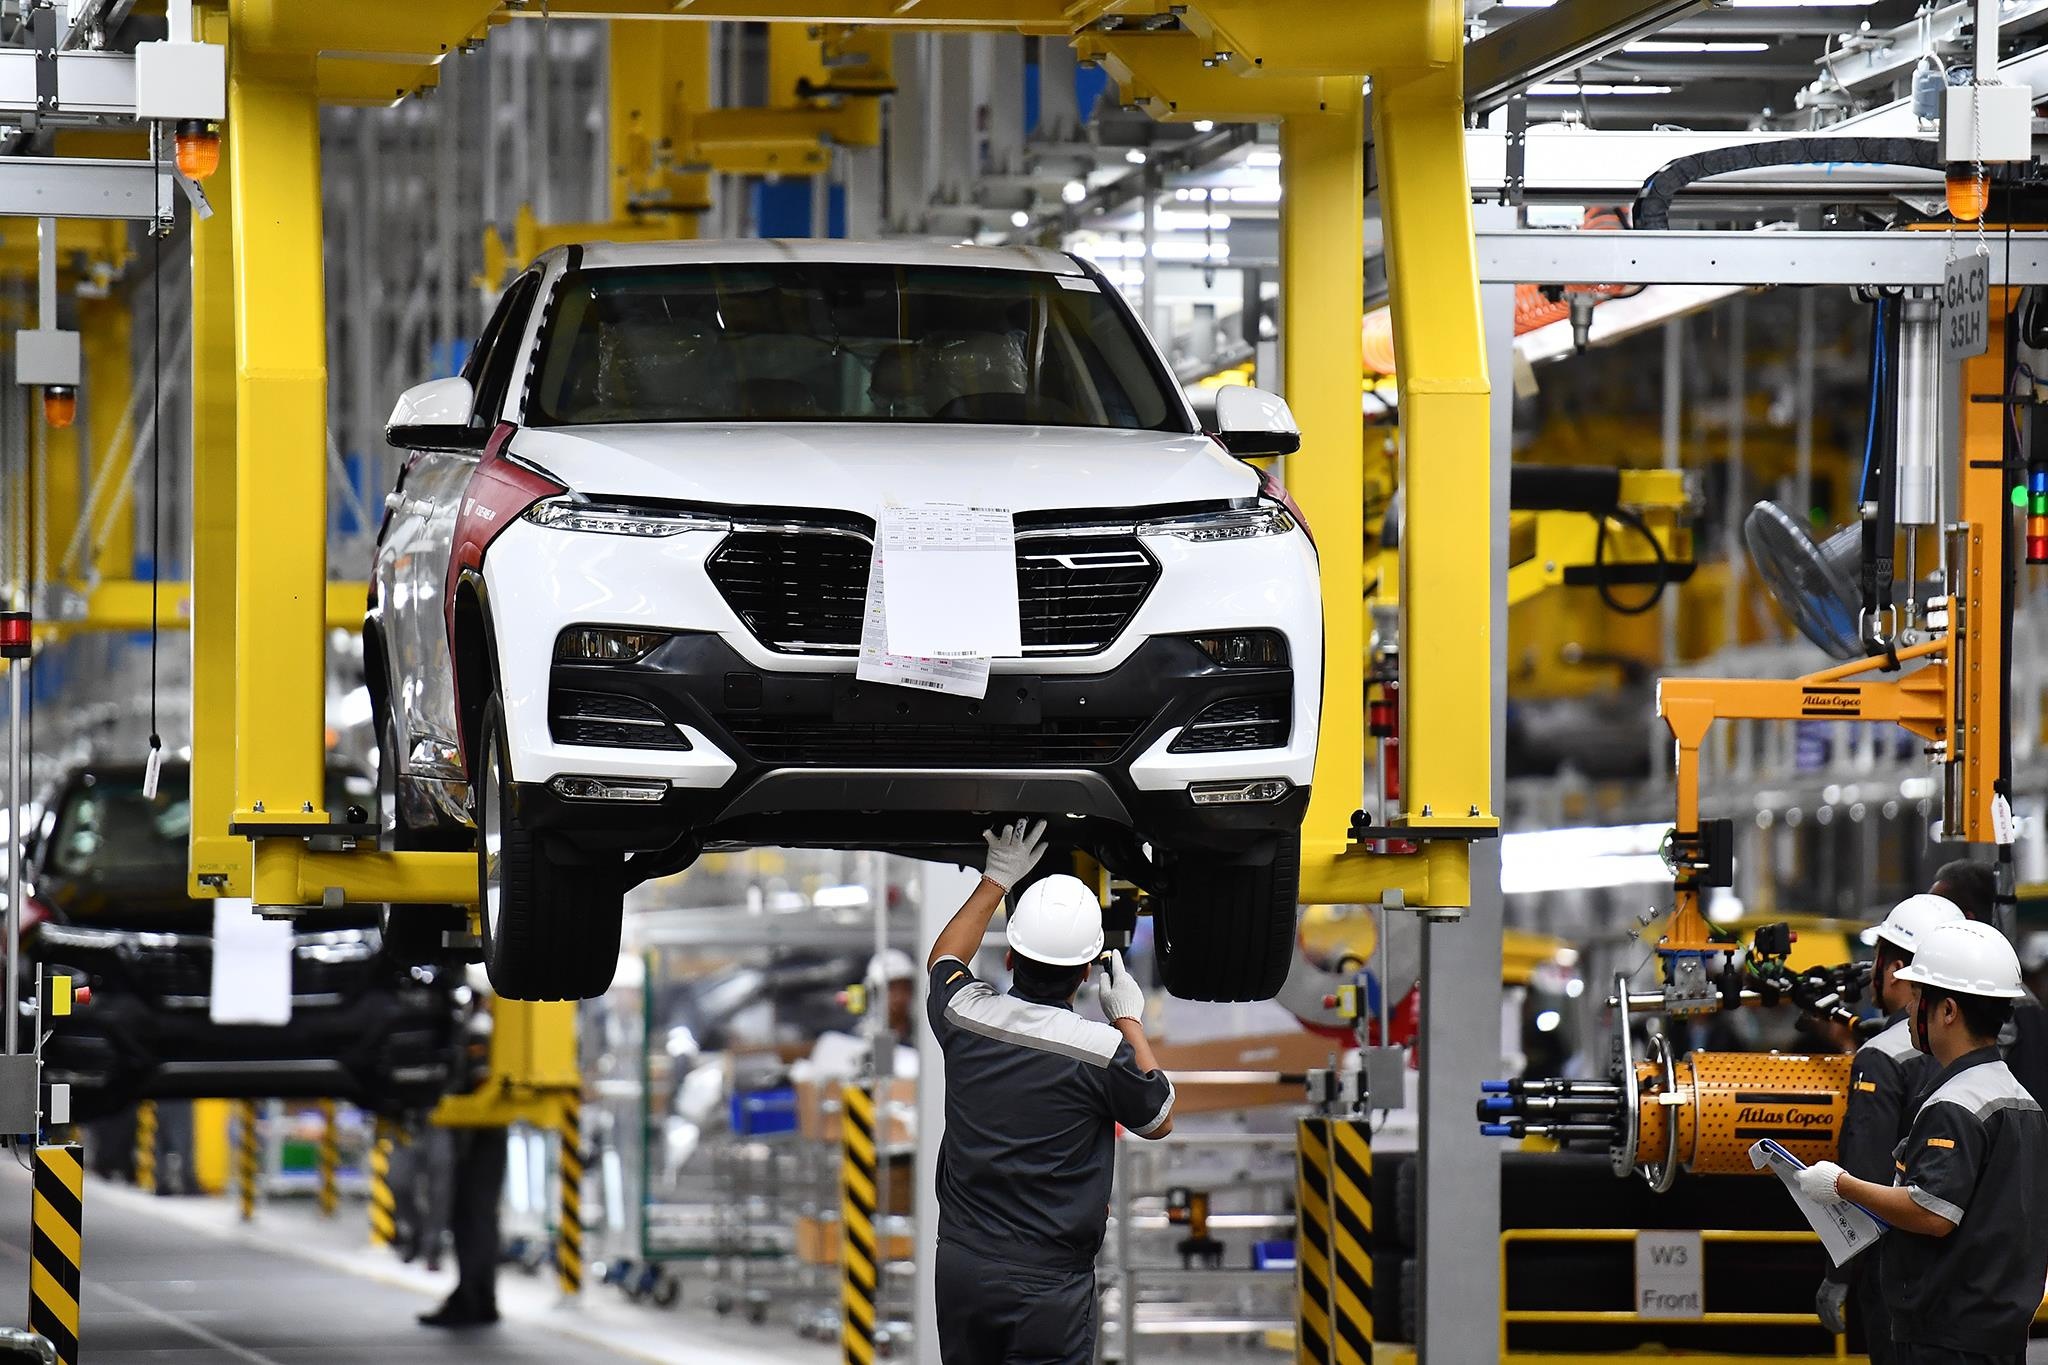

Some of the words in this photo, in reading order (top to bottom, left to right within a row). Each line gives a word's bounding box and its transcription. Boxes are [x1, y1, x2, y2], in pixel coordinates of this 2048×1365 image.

[1947, 268, 1984, 308] GA-C3
[1950, 311, 1980, 348] 35LH
[1803, 696, 1830, 705] Atlas
[1832, 696, 1861, 707] Copco
[1736, 1107, 1783, 1124] Atlas
[1786, 1108, 1833, 1127] Copco
[1650, 1245, 1688, 1265] W3
[1642, 1289, 1699, 1310] Front
